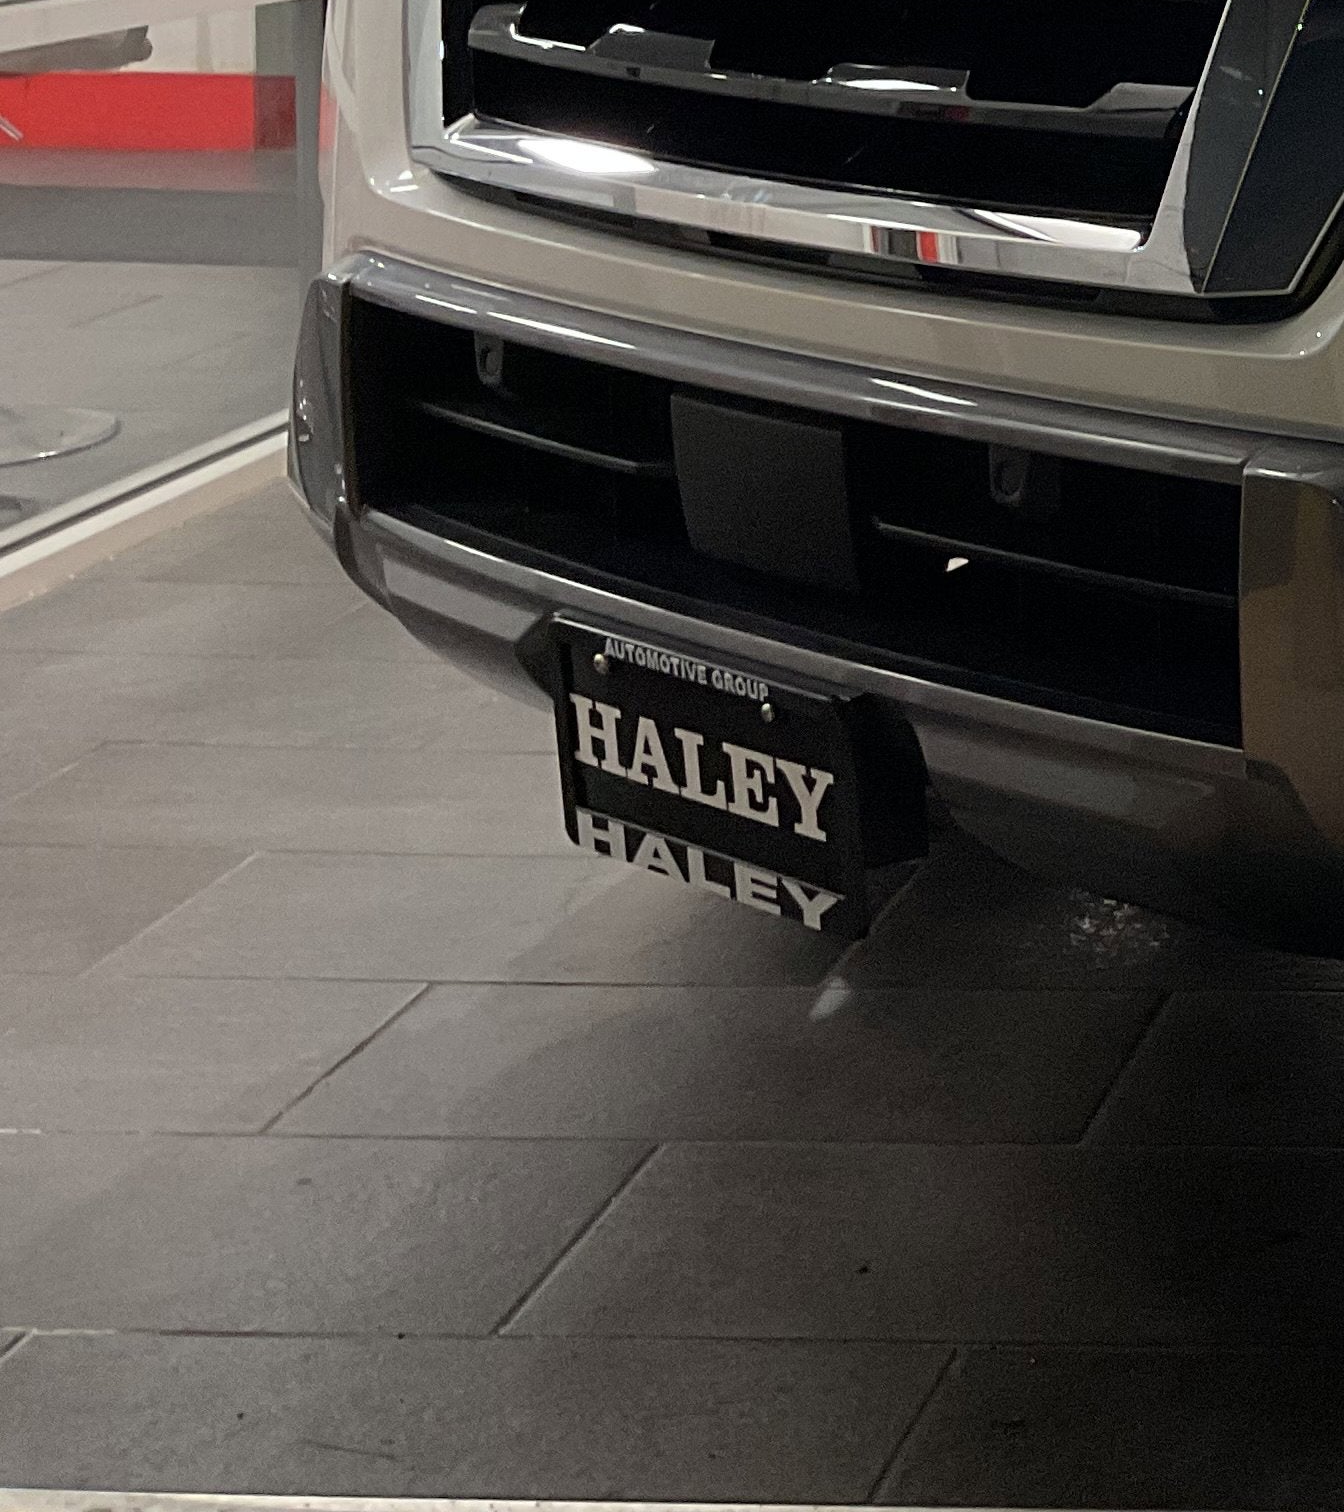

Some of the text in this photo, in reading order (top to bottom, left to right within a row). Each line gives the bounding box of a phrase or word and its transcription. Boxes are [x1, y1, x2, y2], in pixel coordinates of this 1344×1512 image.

[604, 636, 770, 702] AUTOMOTIVE GROUP
[569, 692, 834, 843] HALEY
[575, 807, 840, 932] HALEY
